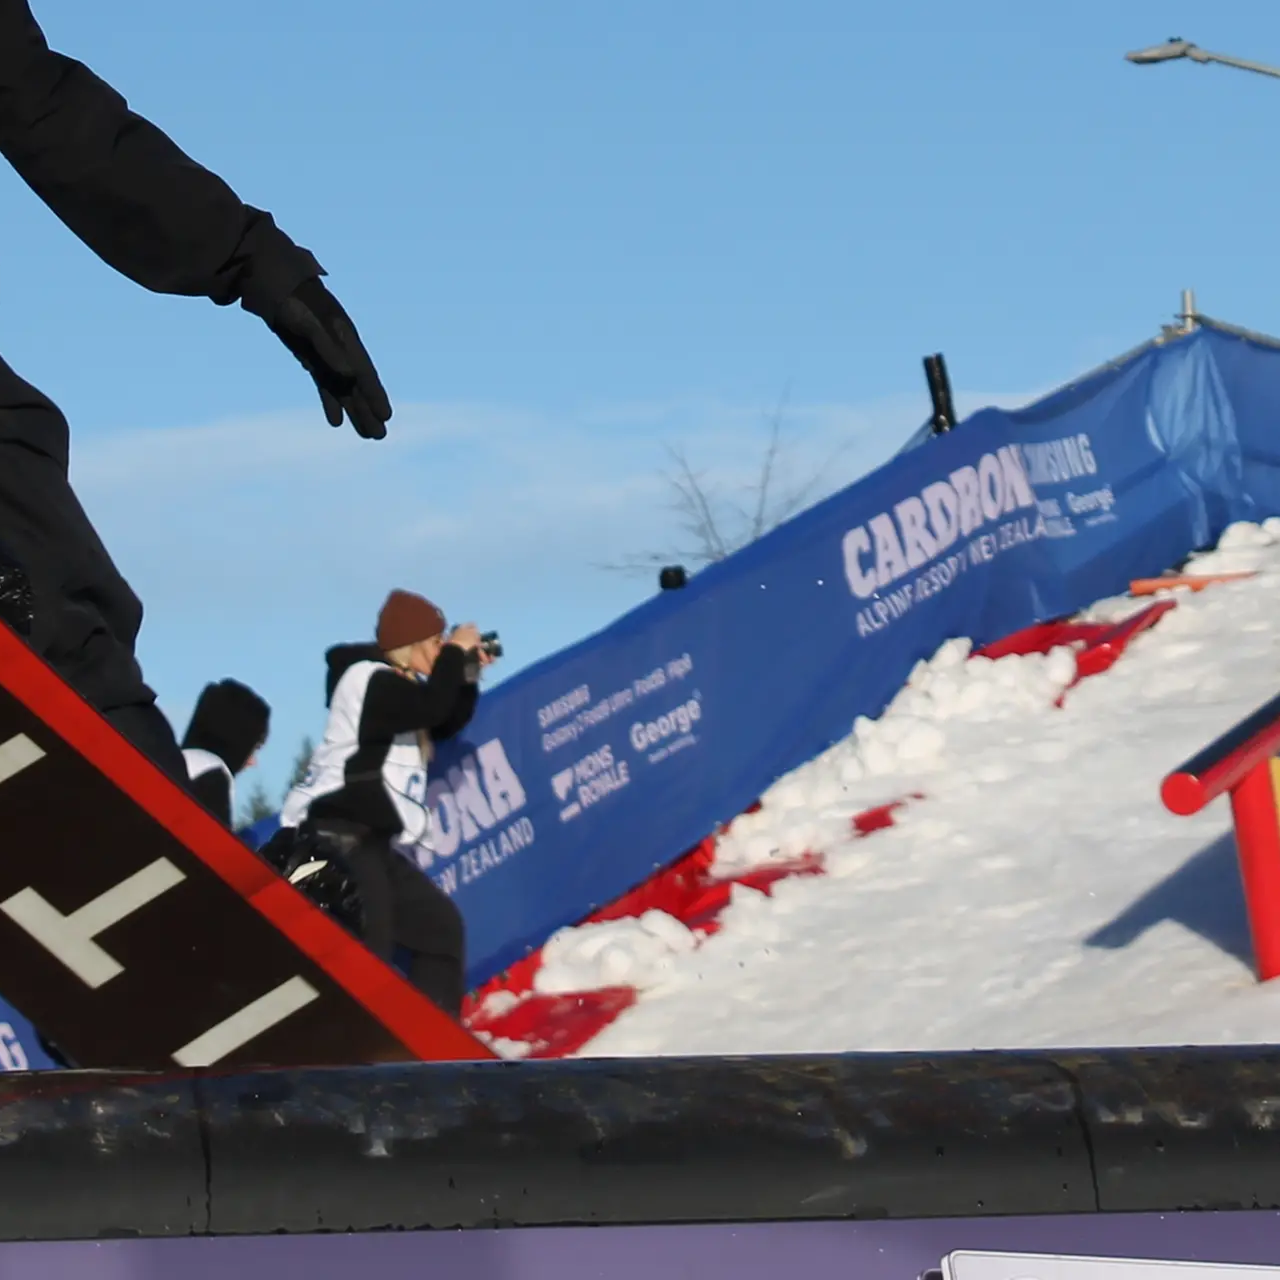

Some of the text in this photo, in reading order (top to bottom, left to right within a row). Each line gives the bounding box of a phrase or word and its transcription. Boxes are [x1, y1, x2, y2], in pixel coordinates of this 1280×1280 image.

[841, 443, 1034, 599] CARDRON
[629, 699, 701, 752] George
[459, 816, 535, 884] ZEALAND
